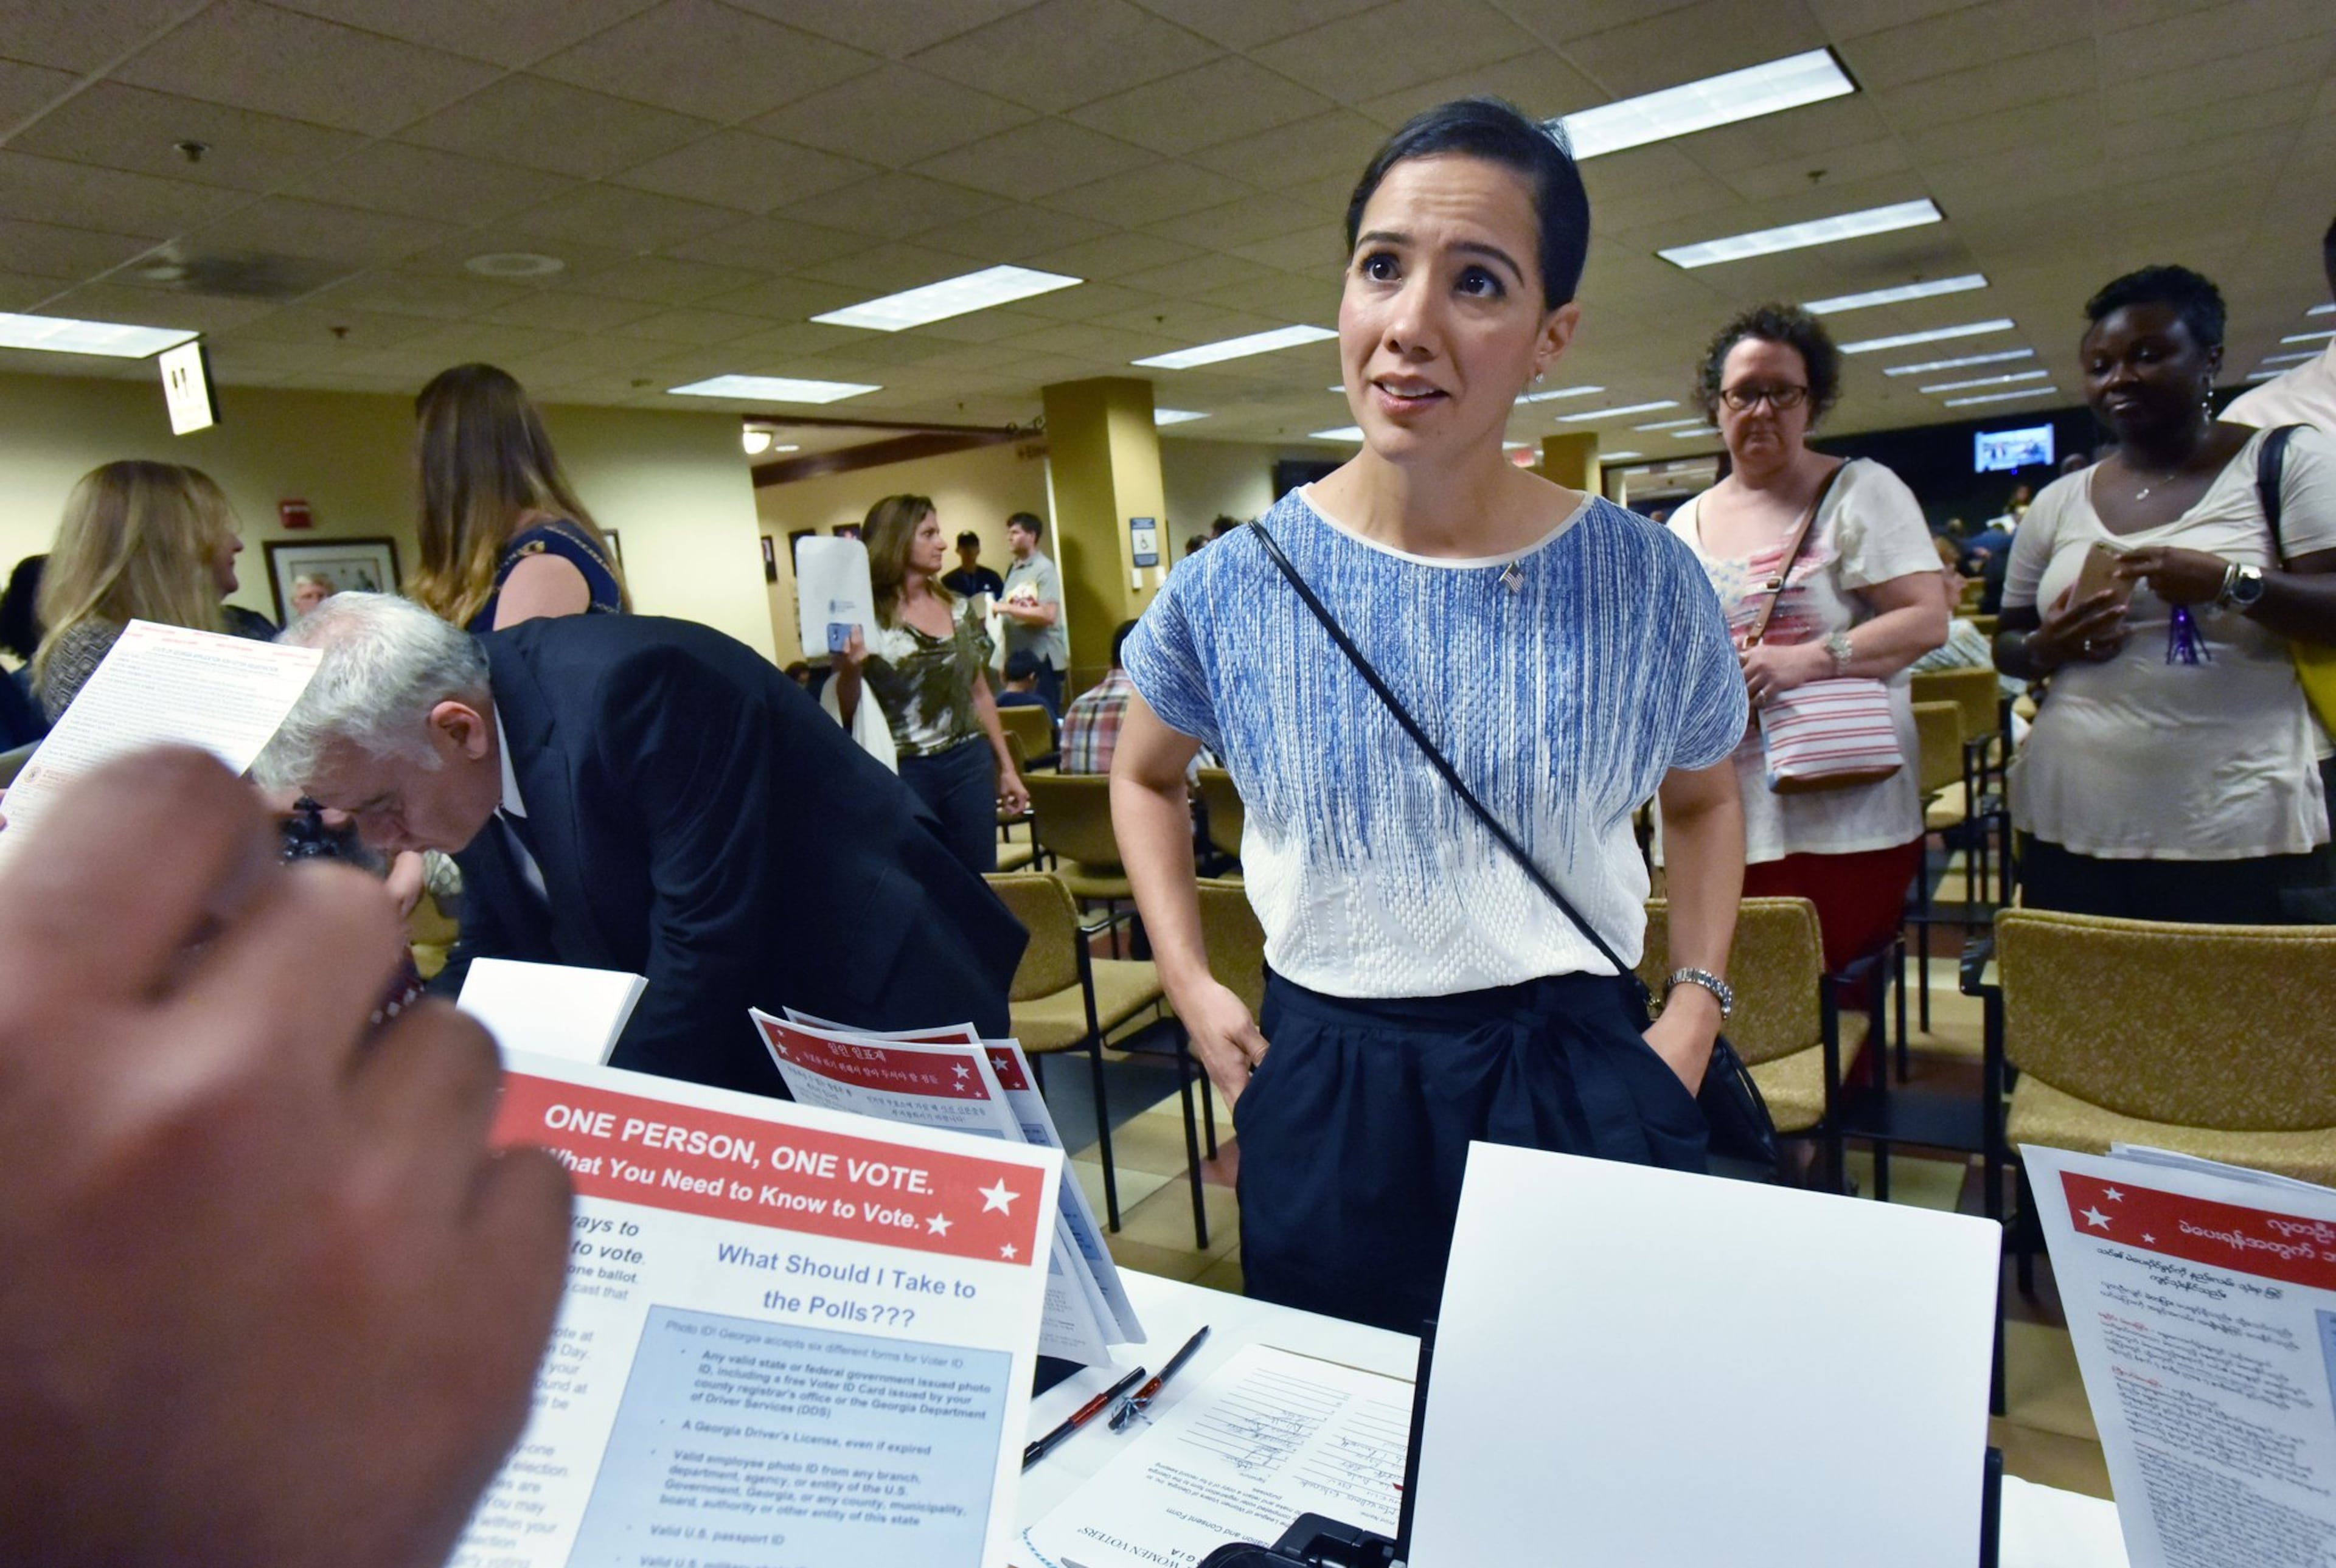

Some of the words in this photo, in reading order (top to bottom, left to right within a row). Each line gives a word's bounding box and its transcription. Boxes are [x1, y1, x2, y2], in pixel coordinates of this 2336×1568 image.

[544, 1104, 616, 1139] ONE
[620, 1118, 760, 1169] PERSON,
[771, 1146, 839, 1179] ONE
[847, 1158, 934, 1196] VOTE.
[610, 1157, 656, 1185] You
[661, 1168, 725, 1196] Need
[729, 1181, 753, 1201] to
[759, 1185, 827, 1214] Know
[833, 1199, 856, 1218] to
[863, 1202, 920, 1230] Vote.
[619, 1221, 639, 1237] to
[571, 1240, 593, 1255] to
[717, 1243, 779, 1271] What
[785, 1254, 870, 1285] Should
[877, 1269, 885, 1286] I
[891, 1269, 946, 1295] Take
[953, 1280, 976, 1299] to
[603, 1285, 628, 1301] that
[763, 1290, 801, 1312] the
[808, 1296, 915, 1328] Polls???
[666, 1320, 697, 1335] Photo
[718, 1328, 762, 1344] Georgia
[764, 1336, 805, 1350] accepts
[826, 1344, 868, 1356] different
[871, 1350, 899, 1362] forms
[903, 1353, 917, 1363] for
[921, 1356, 948, 1367] Voter
[702, 1350, 725, 1364] Any
[729, 1355, 756, 1366] valid
[759, 1359, 787, 1370] state
[805, 1364, 844, 1377] federal
[847, 1370, 914, 1385] government
[918, 1378, 955, 1390] issued
[958, 1383, 992, 1395] photo
[694, 1379, 734, 1393] county
[737, 1386, 796, 1398] registrar's
[799, 1392, 831, 1403] office
[850, 1396, 868, 1407] the
[871, 1398, 916, 1413] Georgia
[920, 1403, 986, 1420] Department
[717, 1367, 770, 1384] including
[784, 1375, 805, 1387] free
[810, 1378, 839, 1390] Voter
[843, 1382, 855, 1392] ID
[858, 1384, 886, 1396] Card
[888, 1387, 926, 1400] issued
[930, 1393, 943, 1403] by
[945, 1395, 972, 1406] your
[690, 1393, 704, 1402] of
[705, 1393, 740, 1406] Driver
[745, 1400, 793, 1414] Services
[797, 1404, 831, 1418] (DDS)
[682, 1420, 691, 1429] A
[695, 1421, 741, 1437] Georgia
[745, 1426, 790, 1441] Driver's
[793, 1432, 842, 1447] License,
[846, 1438, 873, 1449] even
[876, 1441, 885, 1450] if
[888, 1443, 932, 1455] expired
[669, 1465, 740, 1481] department,
[794, 1479, 807, 1487] or
[810, 1479, 843, 1493] entity
[847, 1482, 860, 1491] of
[863, 1483, 881, 1494] the
[674, 1449, 704, 1462] Valid
[706, 1454, 763, 1469] employee
[767, 1461, 802, 1473] photo
[805, 1463, 819, 1474] ID
[821, 1465, 849, 1477] from
[852, 1469, 874, 1480] any
[877, 1470, 922, 1484] branch,
[702, 1499, 758, 1514] authority
[760, 1504, 772, 1513] or
[776, 1505, 808, 1517] other
[812, 1508, 844, 1521] entity
[849, 1511, 862, 1520] of
[864, 1512, 886, 1524] this
[891, 1516, 921, 1525] state
[816, 1496, 838, 1506] any
[889, 1501, 967, 1517] municipality,
[1166, 1507, 1187, 1520] Form
[650, 1525, 681, 1537] Valid
[712, 1531, 768, 1545] passport
[771, 1534, 785, 1545] ID
[1189, 1514, 1222, 1532] Consent
[1223, 1528, 1240, 1538] and
[1130, 1546, 1178, 1567] WOMEN
